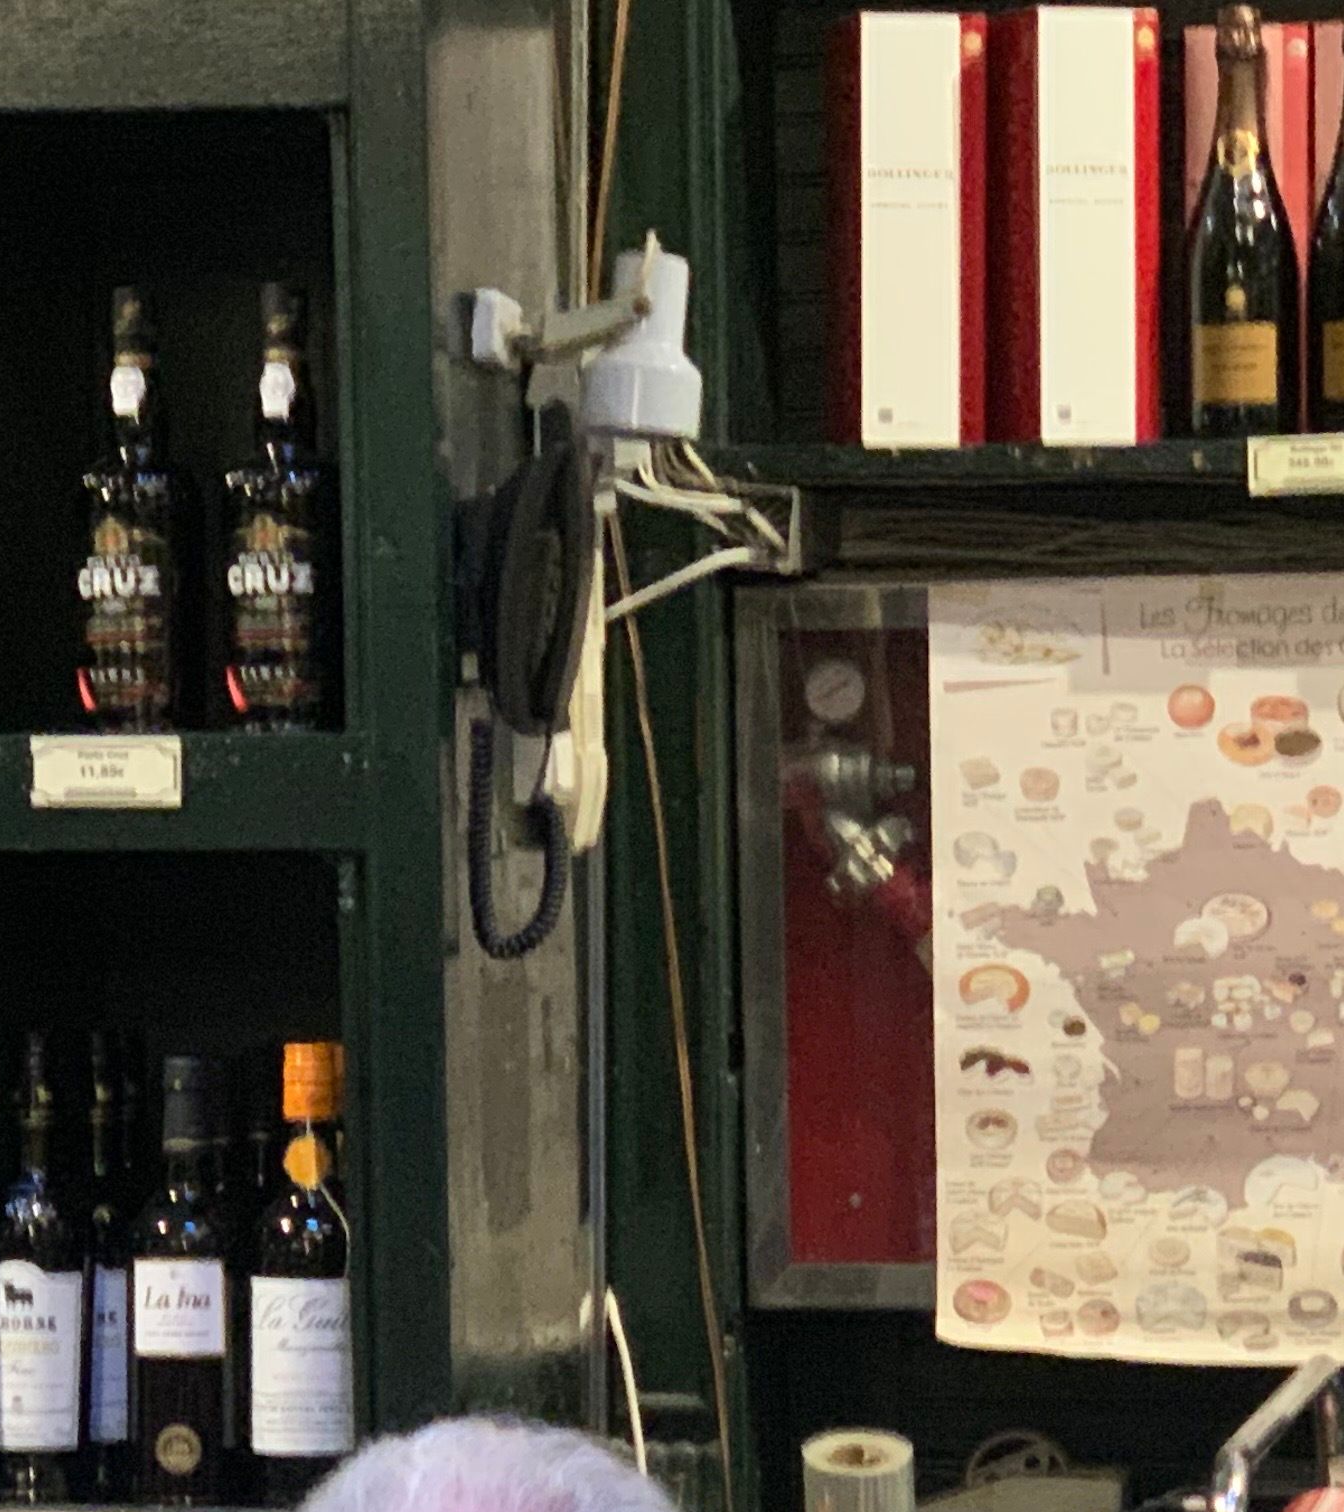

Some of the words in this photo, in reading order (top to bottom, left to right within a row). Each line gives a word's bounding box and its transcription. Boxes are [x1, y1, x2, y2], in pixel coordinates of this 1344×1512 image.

[78, 564, 161, 602] CRUZ
[227, 561, 315, 598] CRUZ
[1140, 602, 1176, 630] Les
[1185, 596, 1312, 636] Fromages
[1161, 639, 1187, 660] La
[143, 1284, 171, 1310] La
